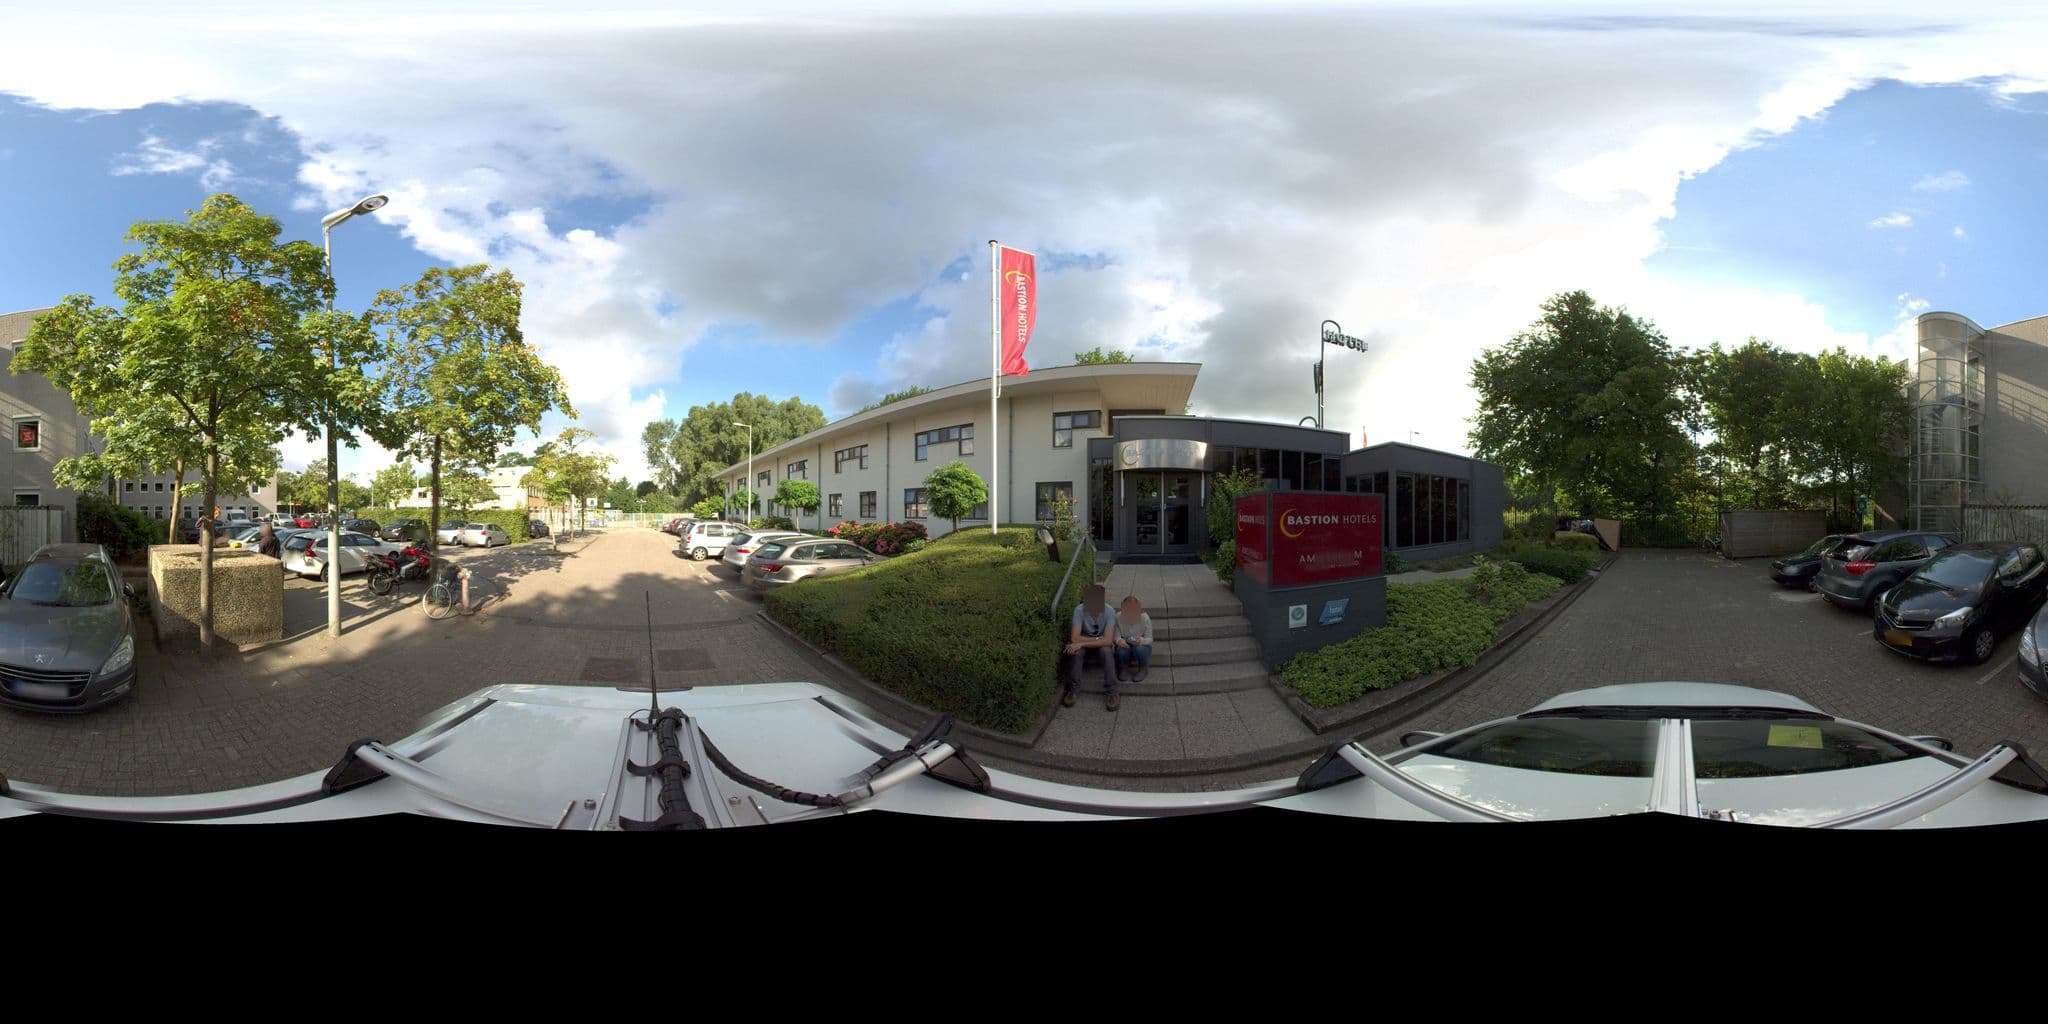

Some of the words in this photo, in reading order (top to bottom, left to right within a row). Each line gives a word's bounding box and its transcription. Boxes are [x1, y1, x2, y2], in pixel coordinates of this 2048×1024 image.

[1017, 312, 1028, 344] HOTELS
[1287, 515, 1339, 525] BASTION
[1342, 514, 1377, 524] HOTELS
